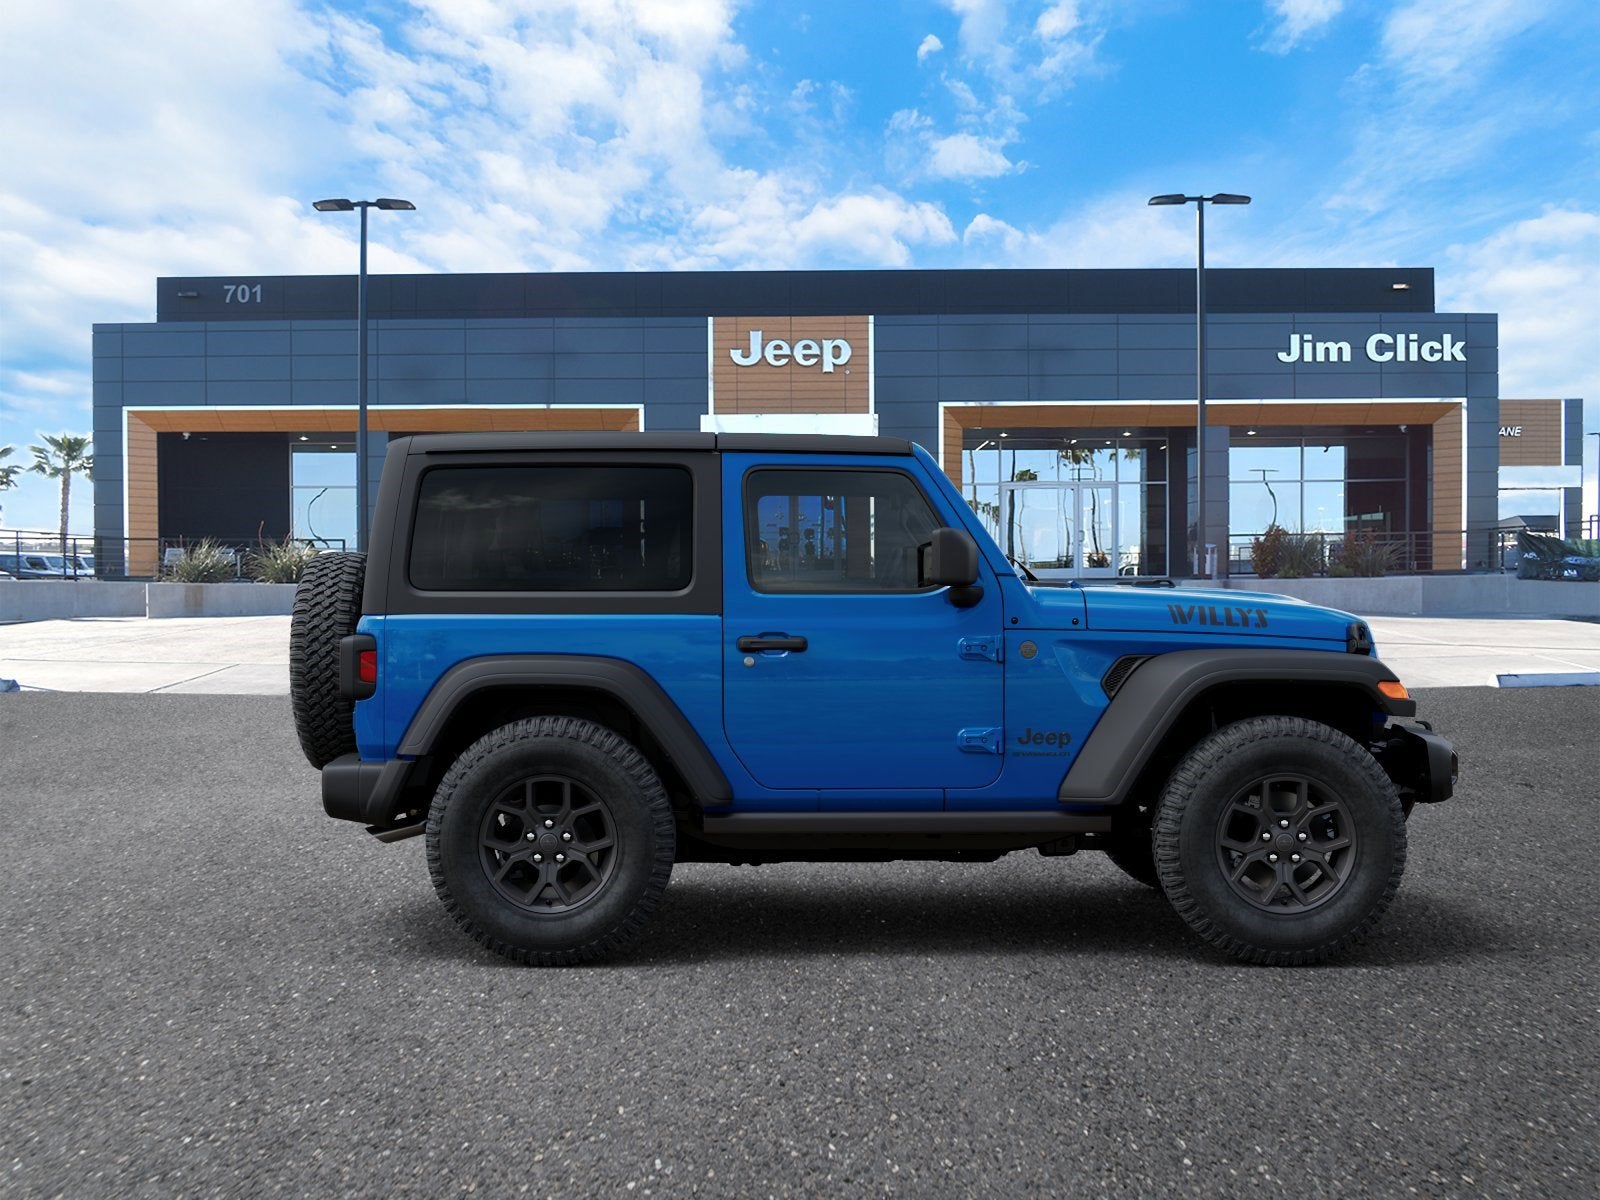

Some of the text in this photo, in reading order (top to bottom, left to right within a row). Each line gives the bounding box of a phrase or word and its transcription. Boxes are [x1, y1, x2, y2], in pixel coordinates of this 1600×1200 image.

[223, 284, 262, 303] 701
[729, 330, 852, 373] Jeep
[1277, 333, 1467, 362] Jim Click
[1167, 604, 1269, 628] WILLYS
[1017, 727, 1071, 749] Jeep
